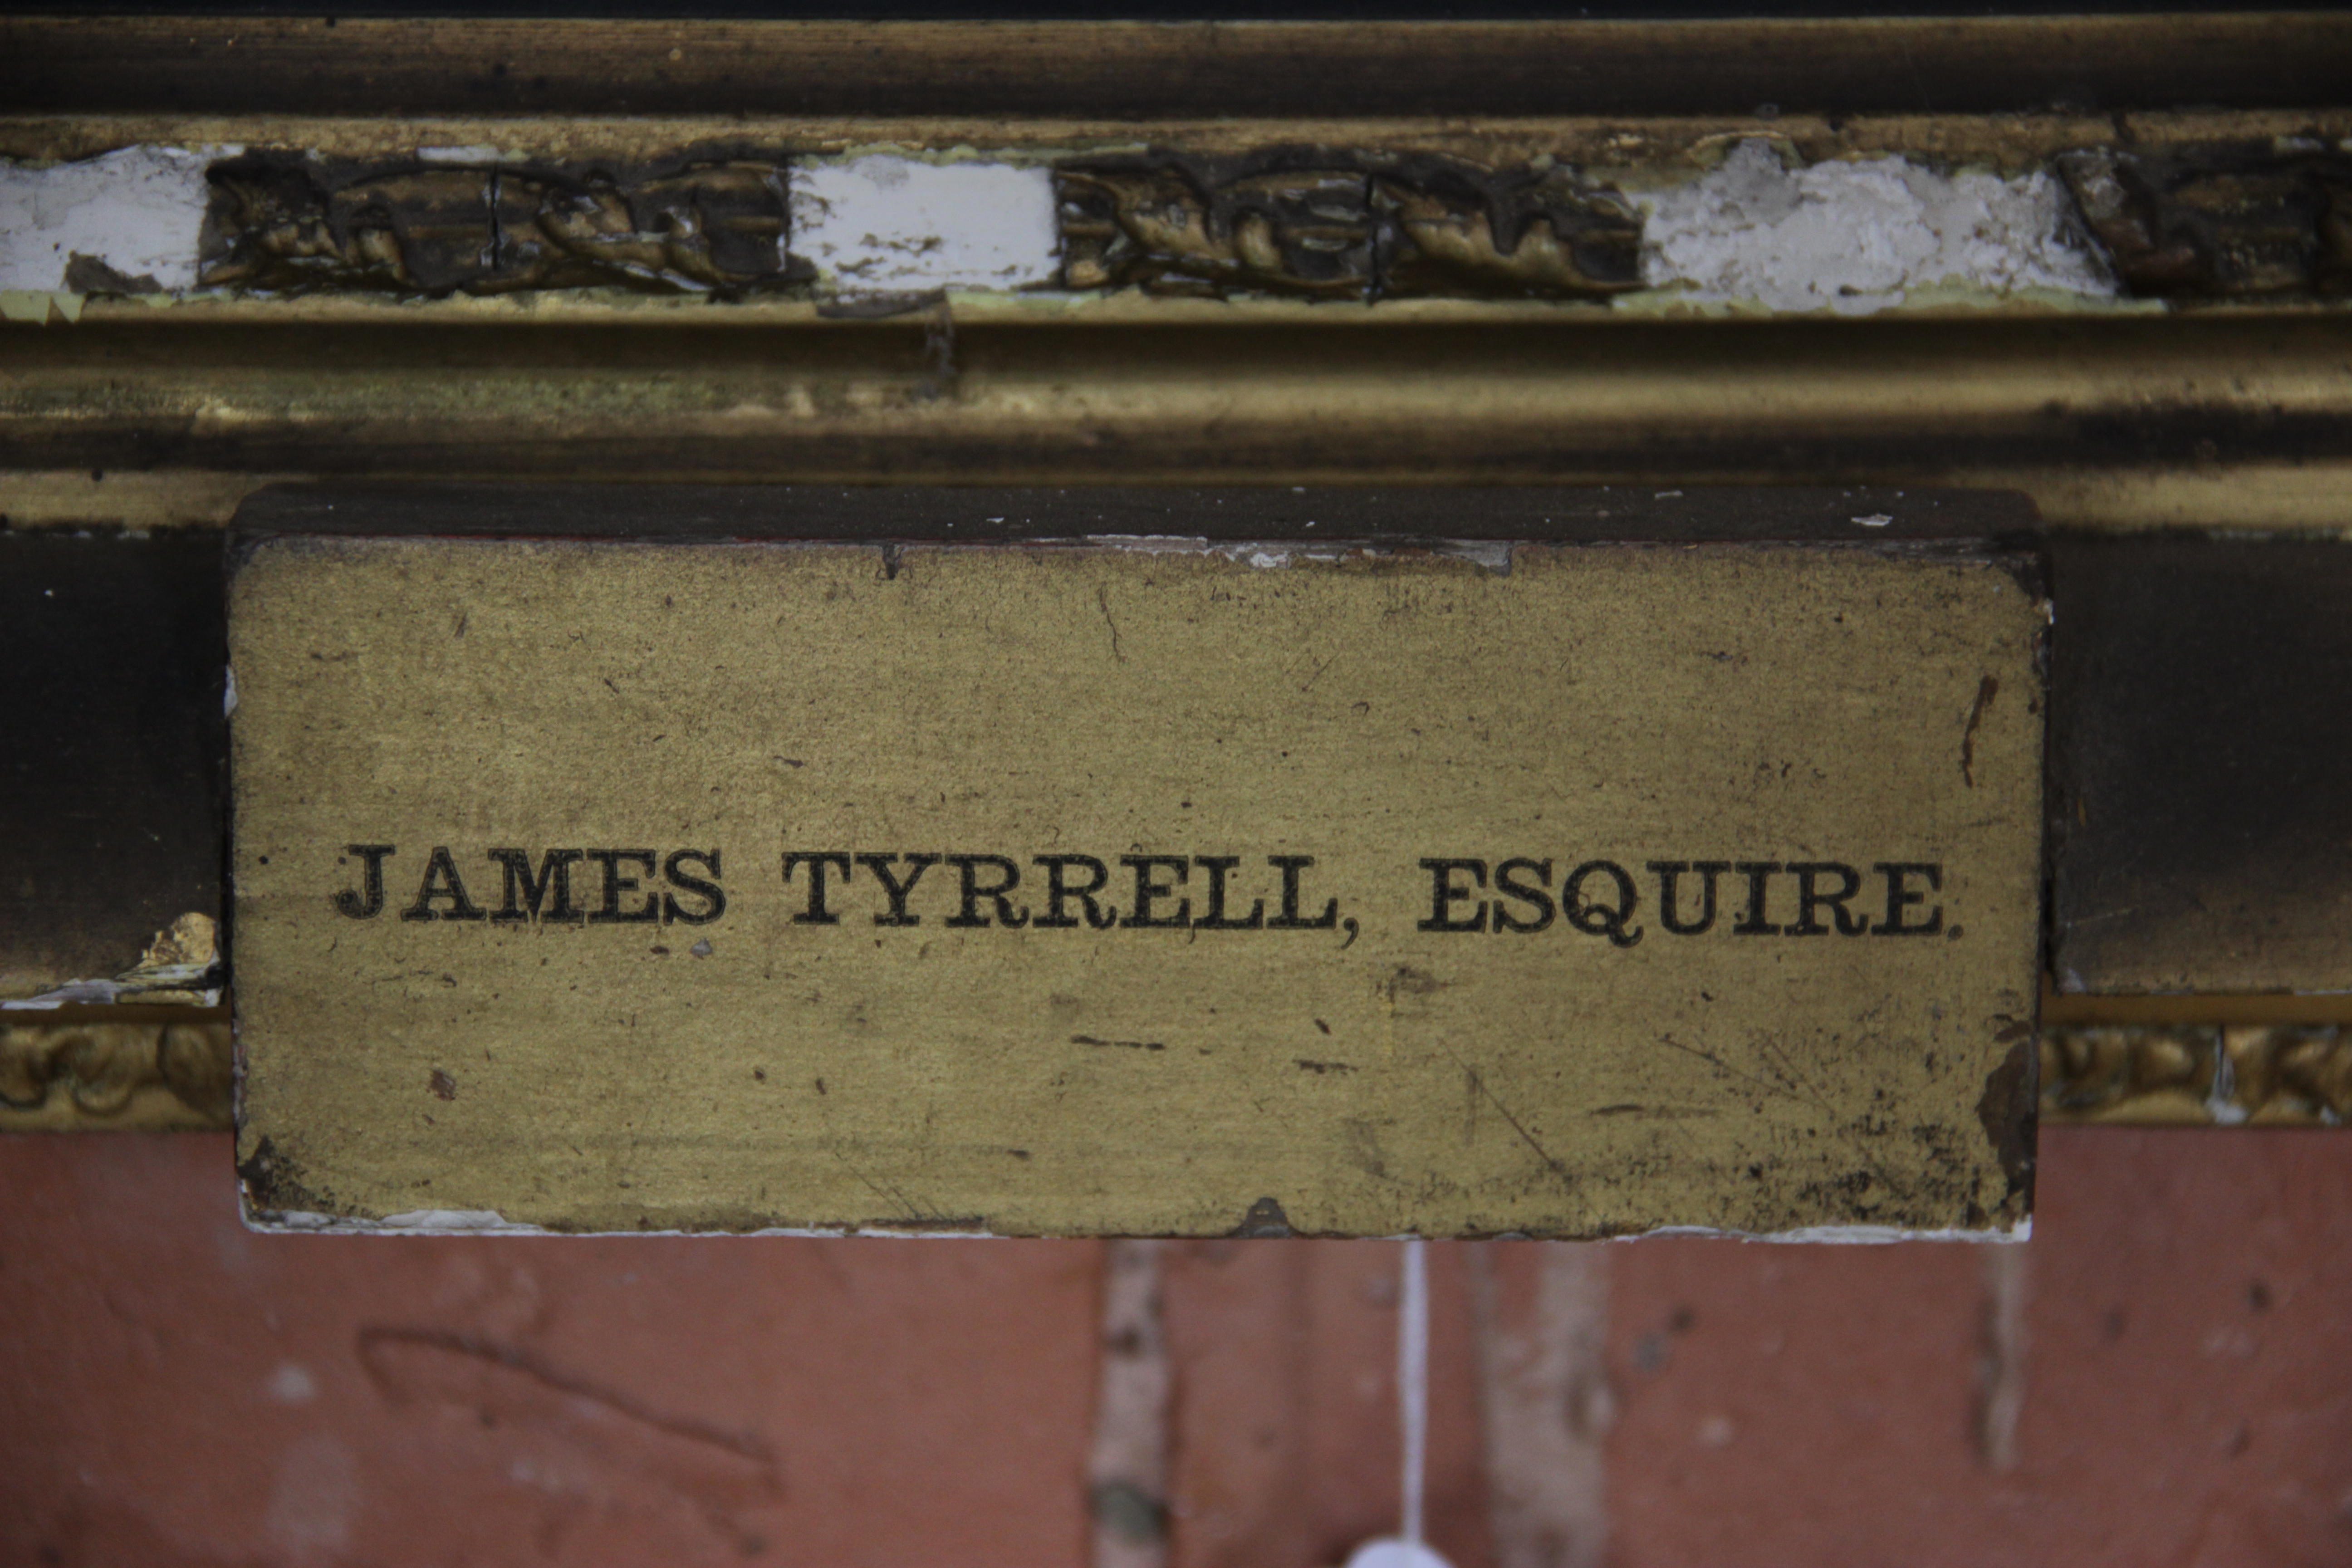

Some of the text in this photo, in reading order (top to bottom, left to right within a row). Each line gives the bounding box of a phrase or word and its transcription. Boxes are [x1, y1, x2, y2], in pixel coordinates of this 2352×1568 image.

[333, 843, 1964, 950] JAMES TYRRELL, ESQUIRE.
